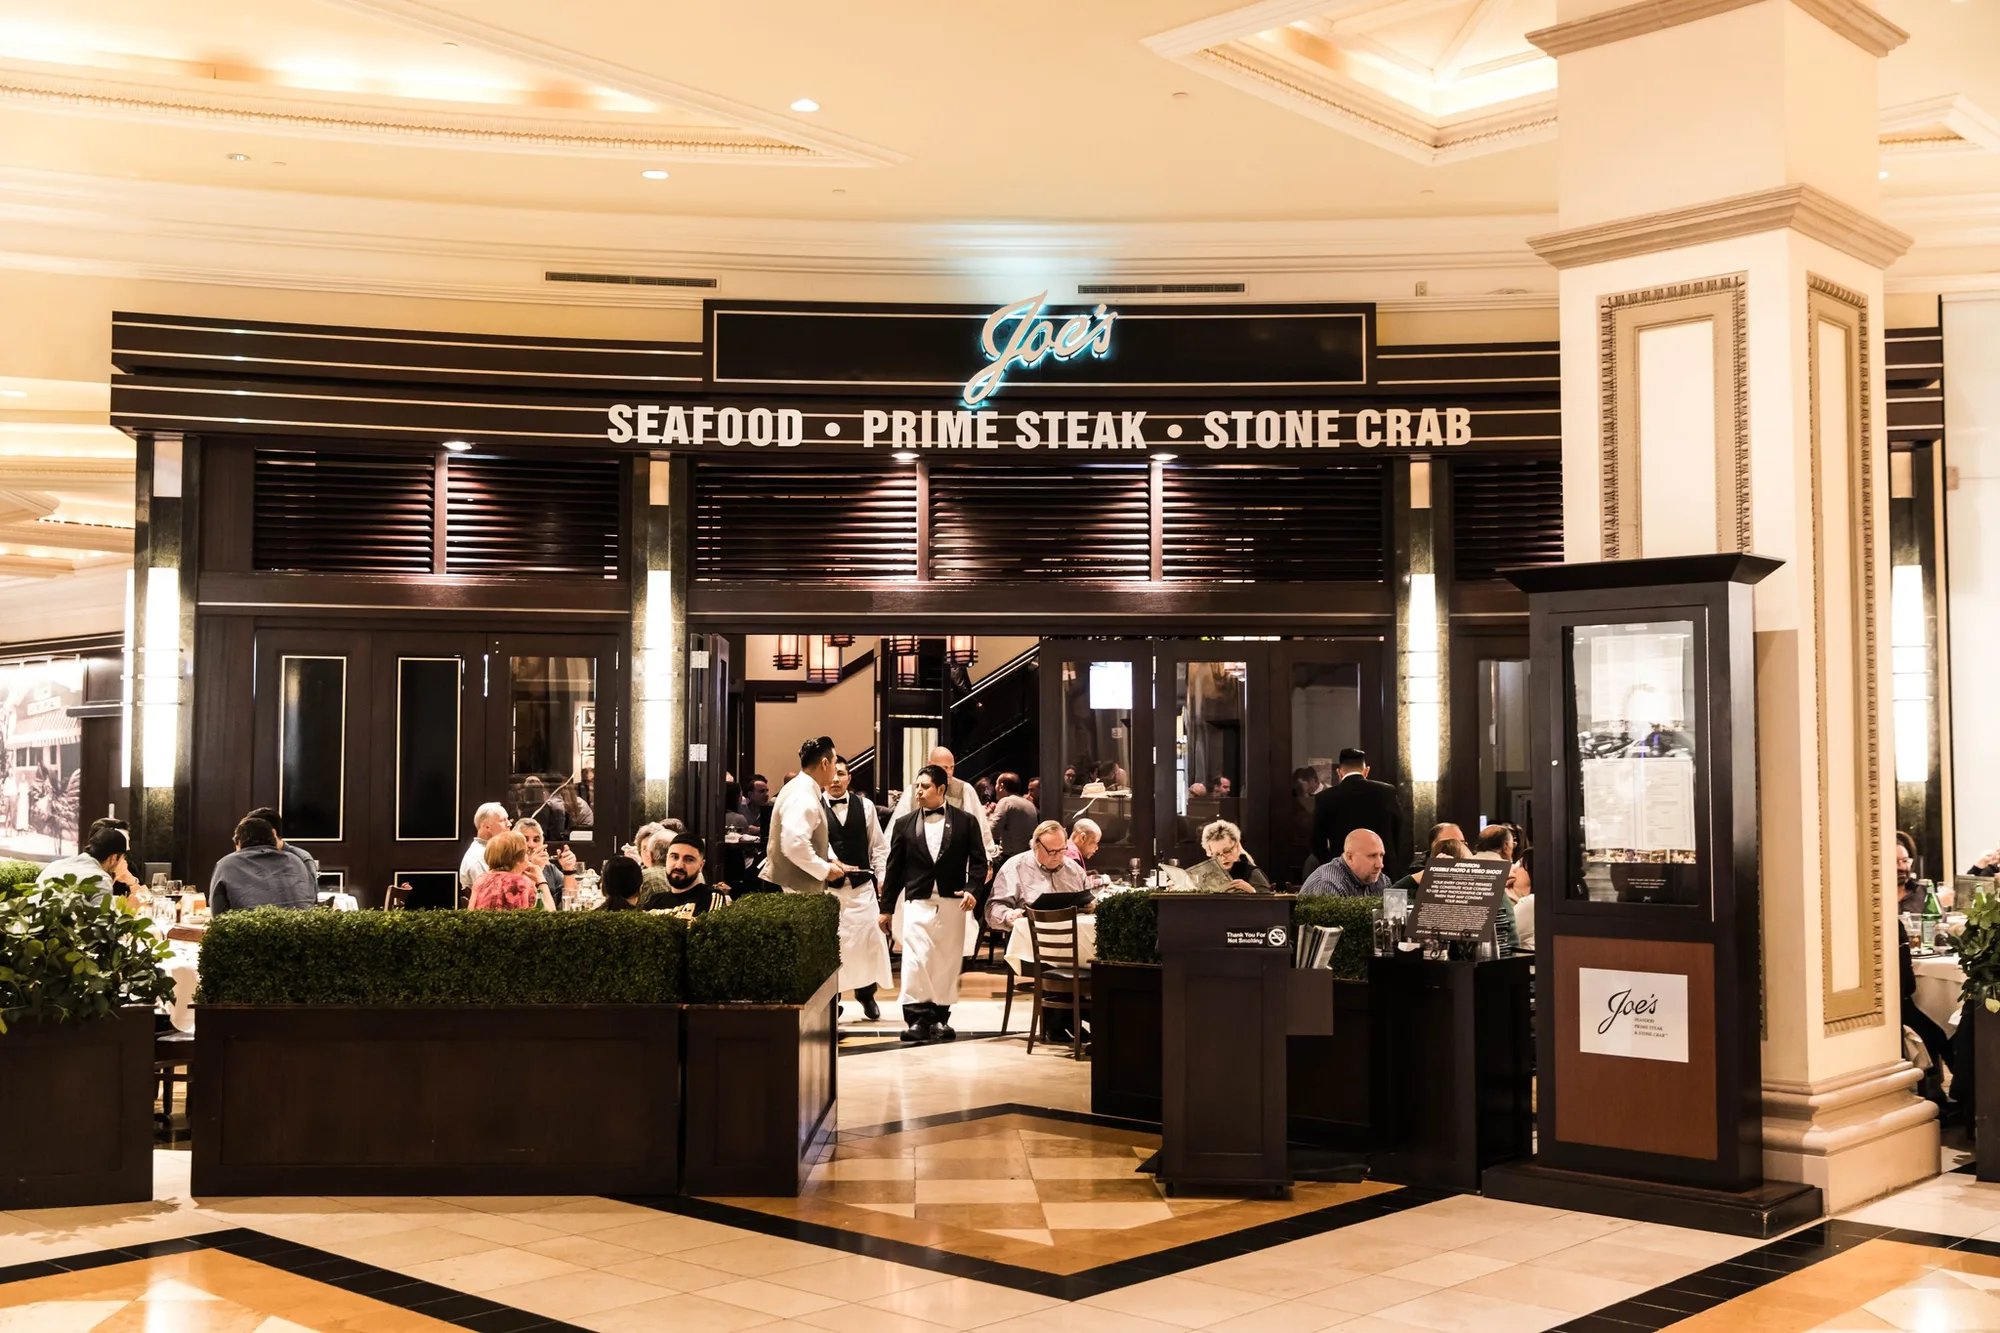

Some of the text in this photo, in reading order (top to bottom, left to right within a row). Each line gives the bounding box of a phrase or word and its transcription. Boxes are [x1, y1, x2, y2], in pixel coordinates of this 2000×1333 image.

[963, 290, 1120, 406] Joe's
[607, 404, 1472, 450] SEAFOOD PRIME STEAK STONE CRAB
[1598, 988, 1658, 1034] Joe's
